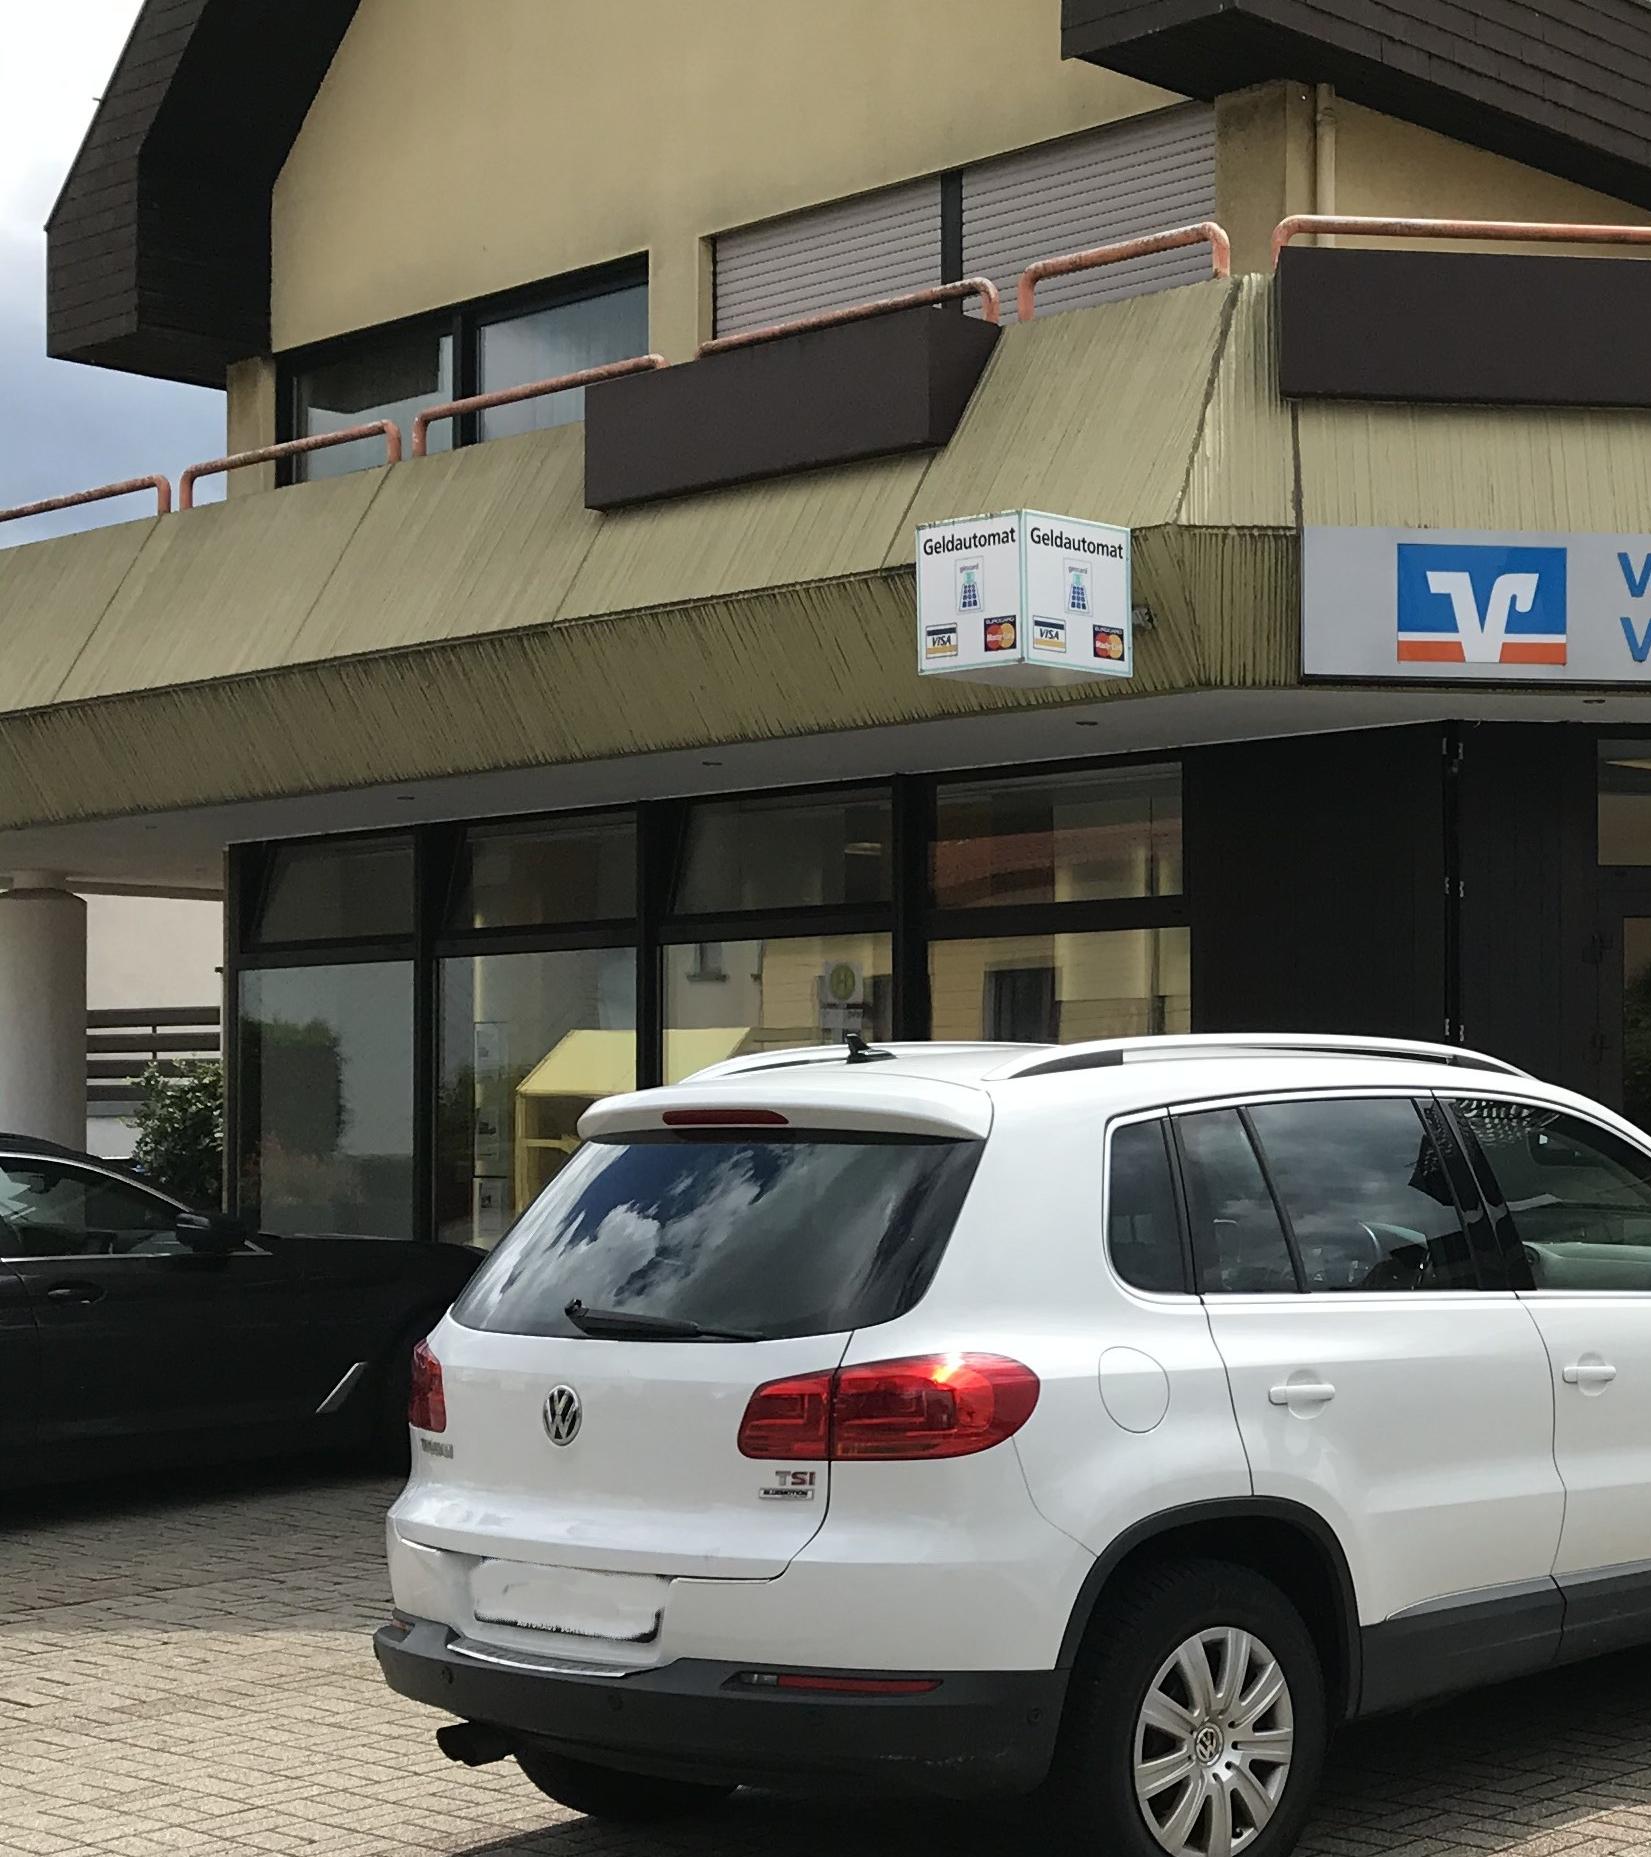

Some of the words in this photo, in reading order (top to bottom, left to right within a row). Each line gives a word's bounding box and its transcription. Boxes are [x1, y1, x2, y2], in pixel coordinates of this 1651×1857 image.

[923, 527, 1016, 556] Geldautomat
[1030, 527, 1124, 559] Geldautomat
[932, 635, 952, 647] VISA
[1040, 628, 1060, 641] VISA
[775, 1470, 816, 1486] TSI
